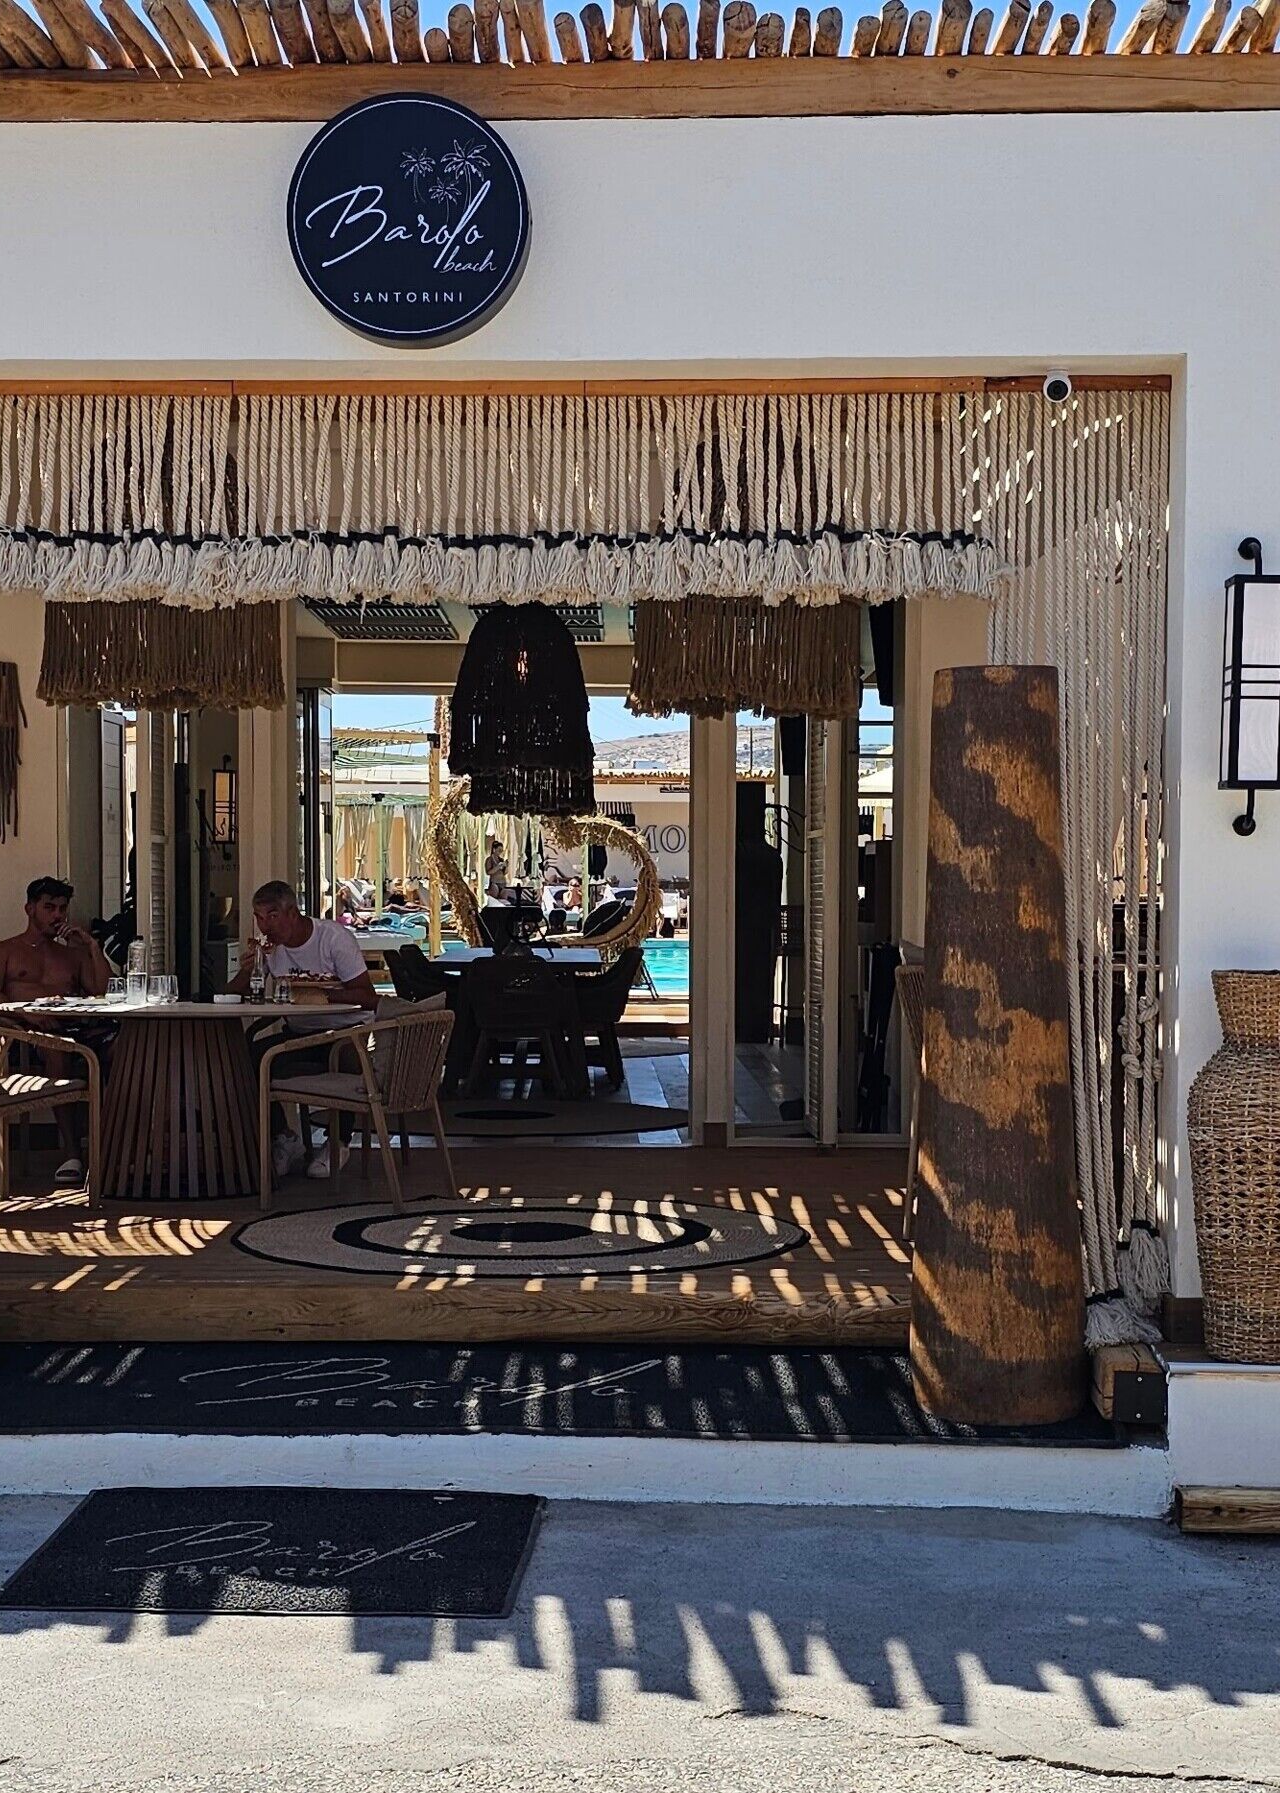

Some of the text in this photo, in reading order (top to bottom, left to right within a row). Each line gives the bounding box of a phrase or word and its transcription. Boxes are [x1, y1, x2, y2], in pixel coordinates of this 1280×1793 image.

[305, 179, 491, 269] Barolo
[438, 245, 497, 274] beach
[353, 291, 464, 303] SANTORINI
[178, 1357, 663, 1407] Barolo
[105, 1520, 478, 1577] Barolo
